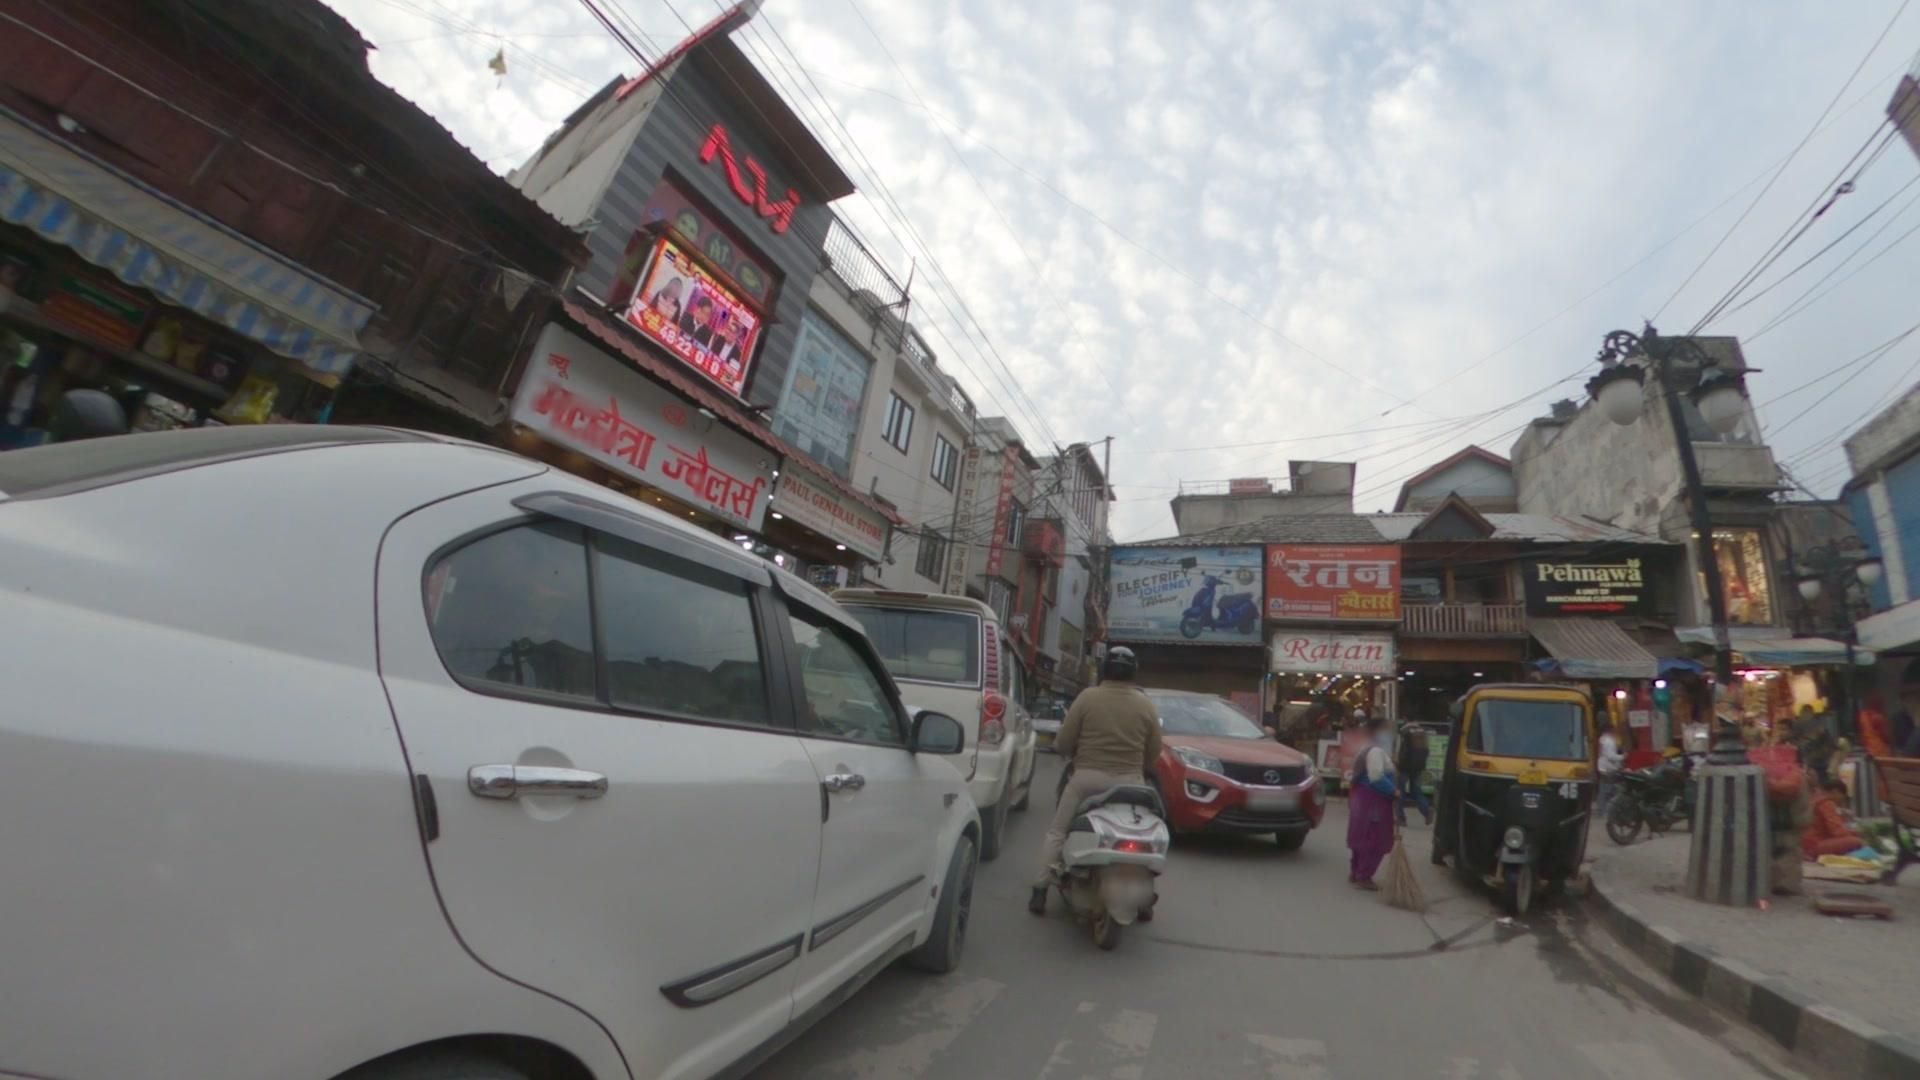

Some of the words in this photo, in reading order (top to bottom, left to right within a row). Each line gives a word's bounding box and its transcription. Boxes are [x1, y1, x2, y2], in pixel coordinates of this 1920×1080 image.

[782, 475, 810, 501] PAUL
[812, 494, 855, 526] GENERAL
[856, 519, 884, 541] STORE
[1116, 569, 1190, 593] ELECTRIFY
[1286, 559, 1397, 589] रतन
[1536, 560, 1642, 582] Pehnawa
[1138, 577, 1193, 598] JOURNEY
[1283, 638, 1384, 664] Ratan
